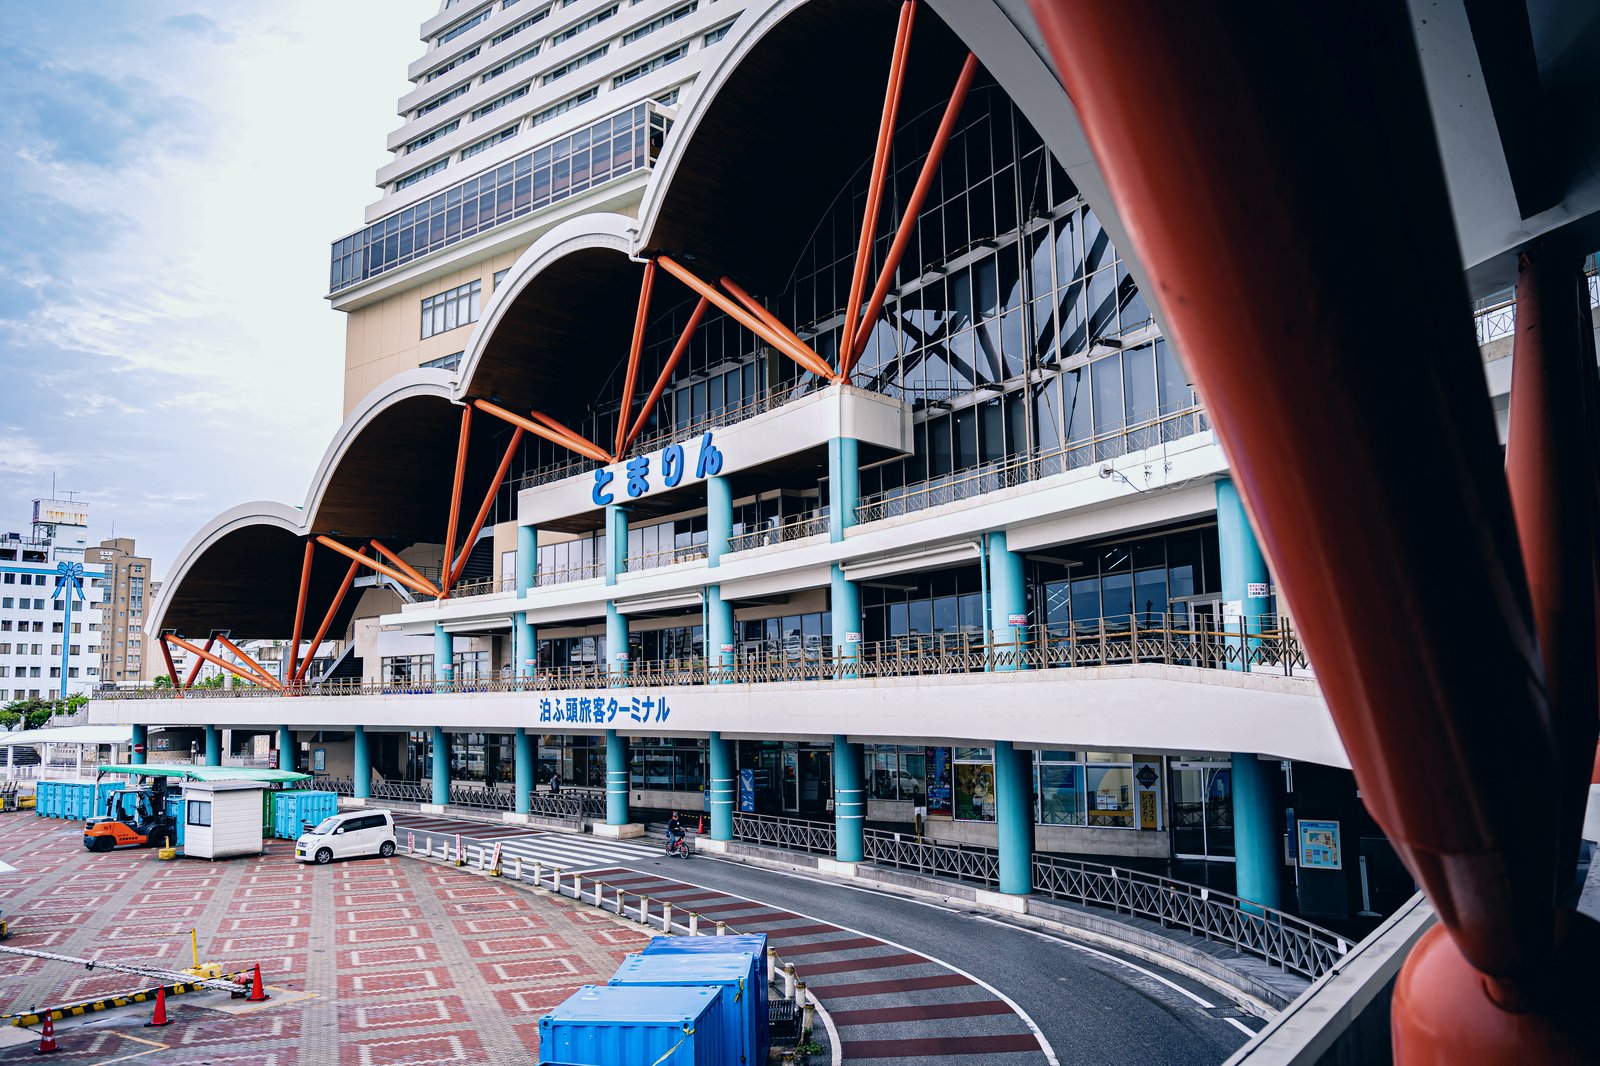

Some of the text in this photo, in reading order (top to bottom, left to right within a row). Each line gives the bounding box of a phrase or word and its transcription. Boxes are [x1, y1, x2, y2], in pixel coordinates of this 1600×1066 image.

[592, 431, 723, 505] とまりん
[539, 695, 671, 723] 泊ふ頭旅客ターミナル
